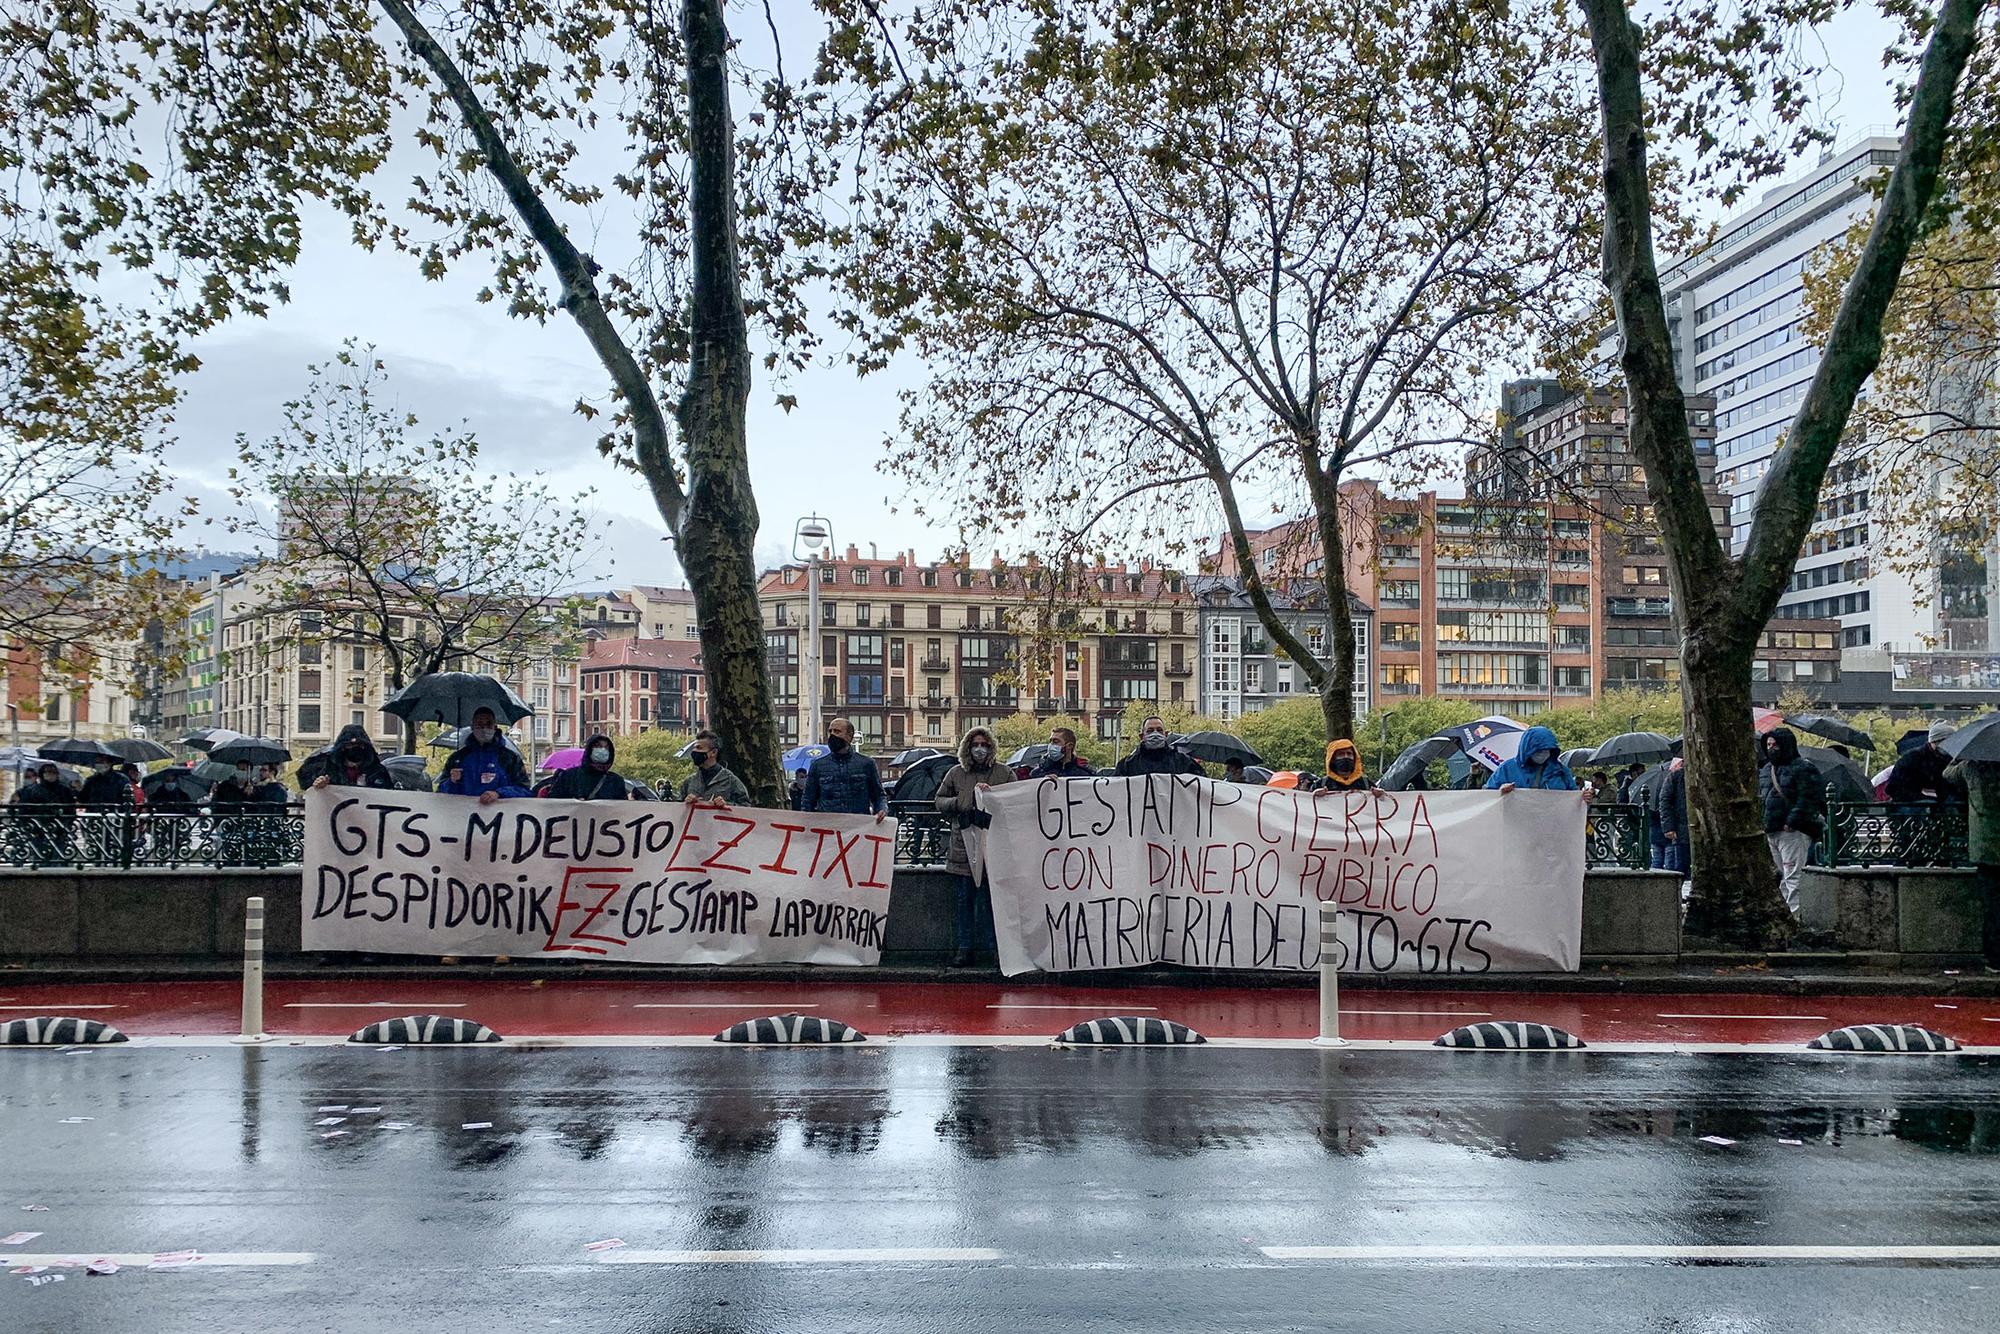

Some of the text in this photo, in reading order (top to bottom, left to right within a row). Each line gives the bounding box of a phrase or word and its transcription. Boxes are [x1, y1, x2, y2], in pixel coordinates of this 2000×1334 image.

[665, 803, 757, 874] EZ
[759, 822, 893, 889] ITXI
[1257, 789, 1439, 858] CIERRA
[1042, 845, 1113, 890] CON
[769, 897, 889, 951] LAPURRAK
[1045, 894, 1235, 969] MATRICERIA
